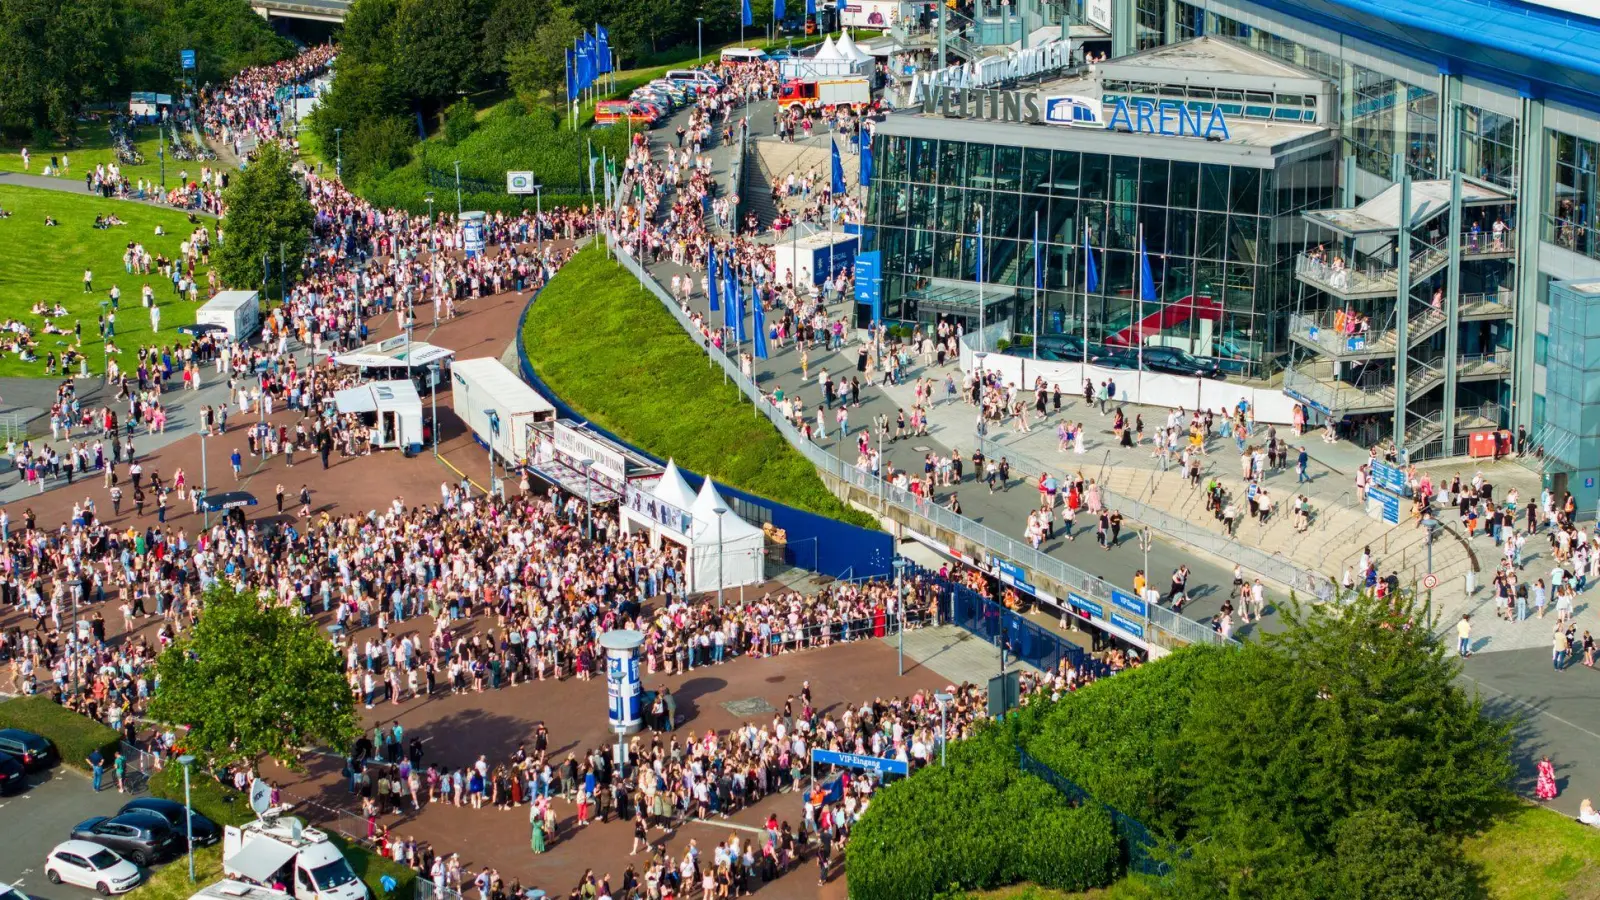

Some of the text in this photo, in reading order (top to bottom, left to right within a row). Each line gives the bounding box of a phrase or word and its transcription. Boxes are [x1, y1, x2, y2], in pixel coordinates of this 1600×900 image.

[922, 84, 1232, 141] VELTINS ARENA
[839, 754, 881, 769] VIP-Eingang
